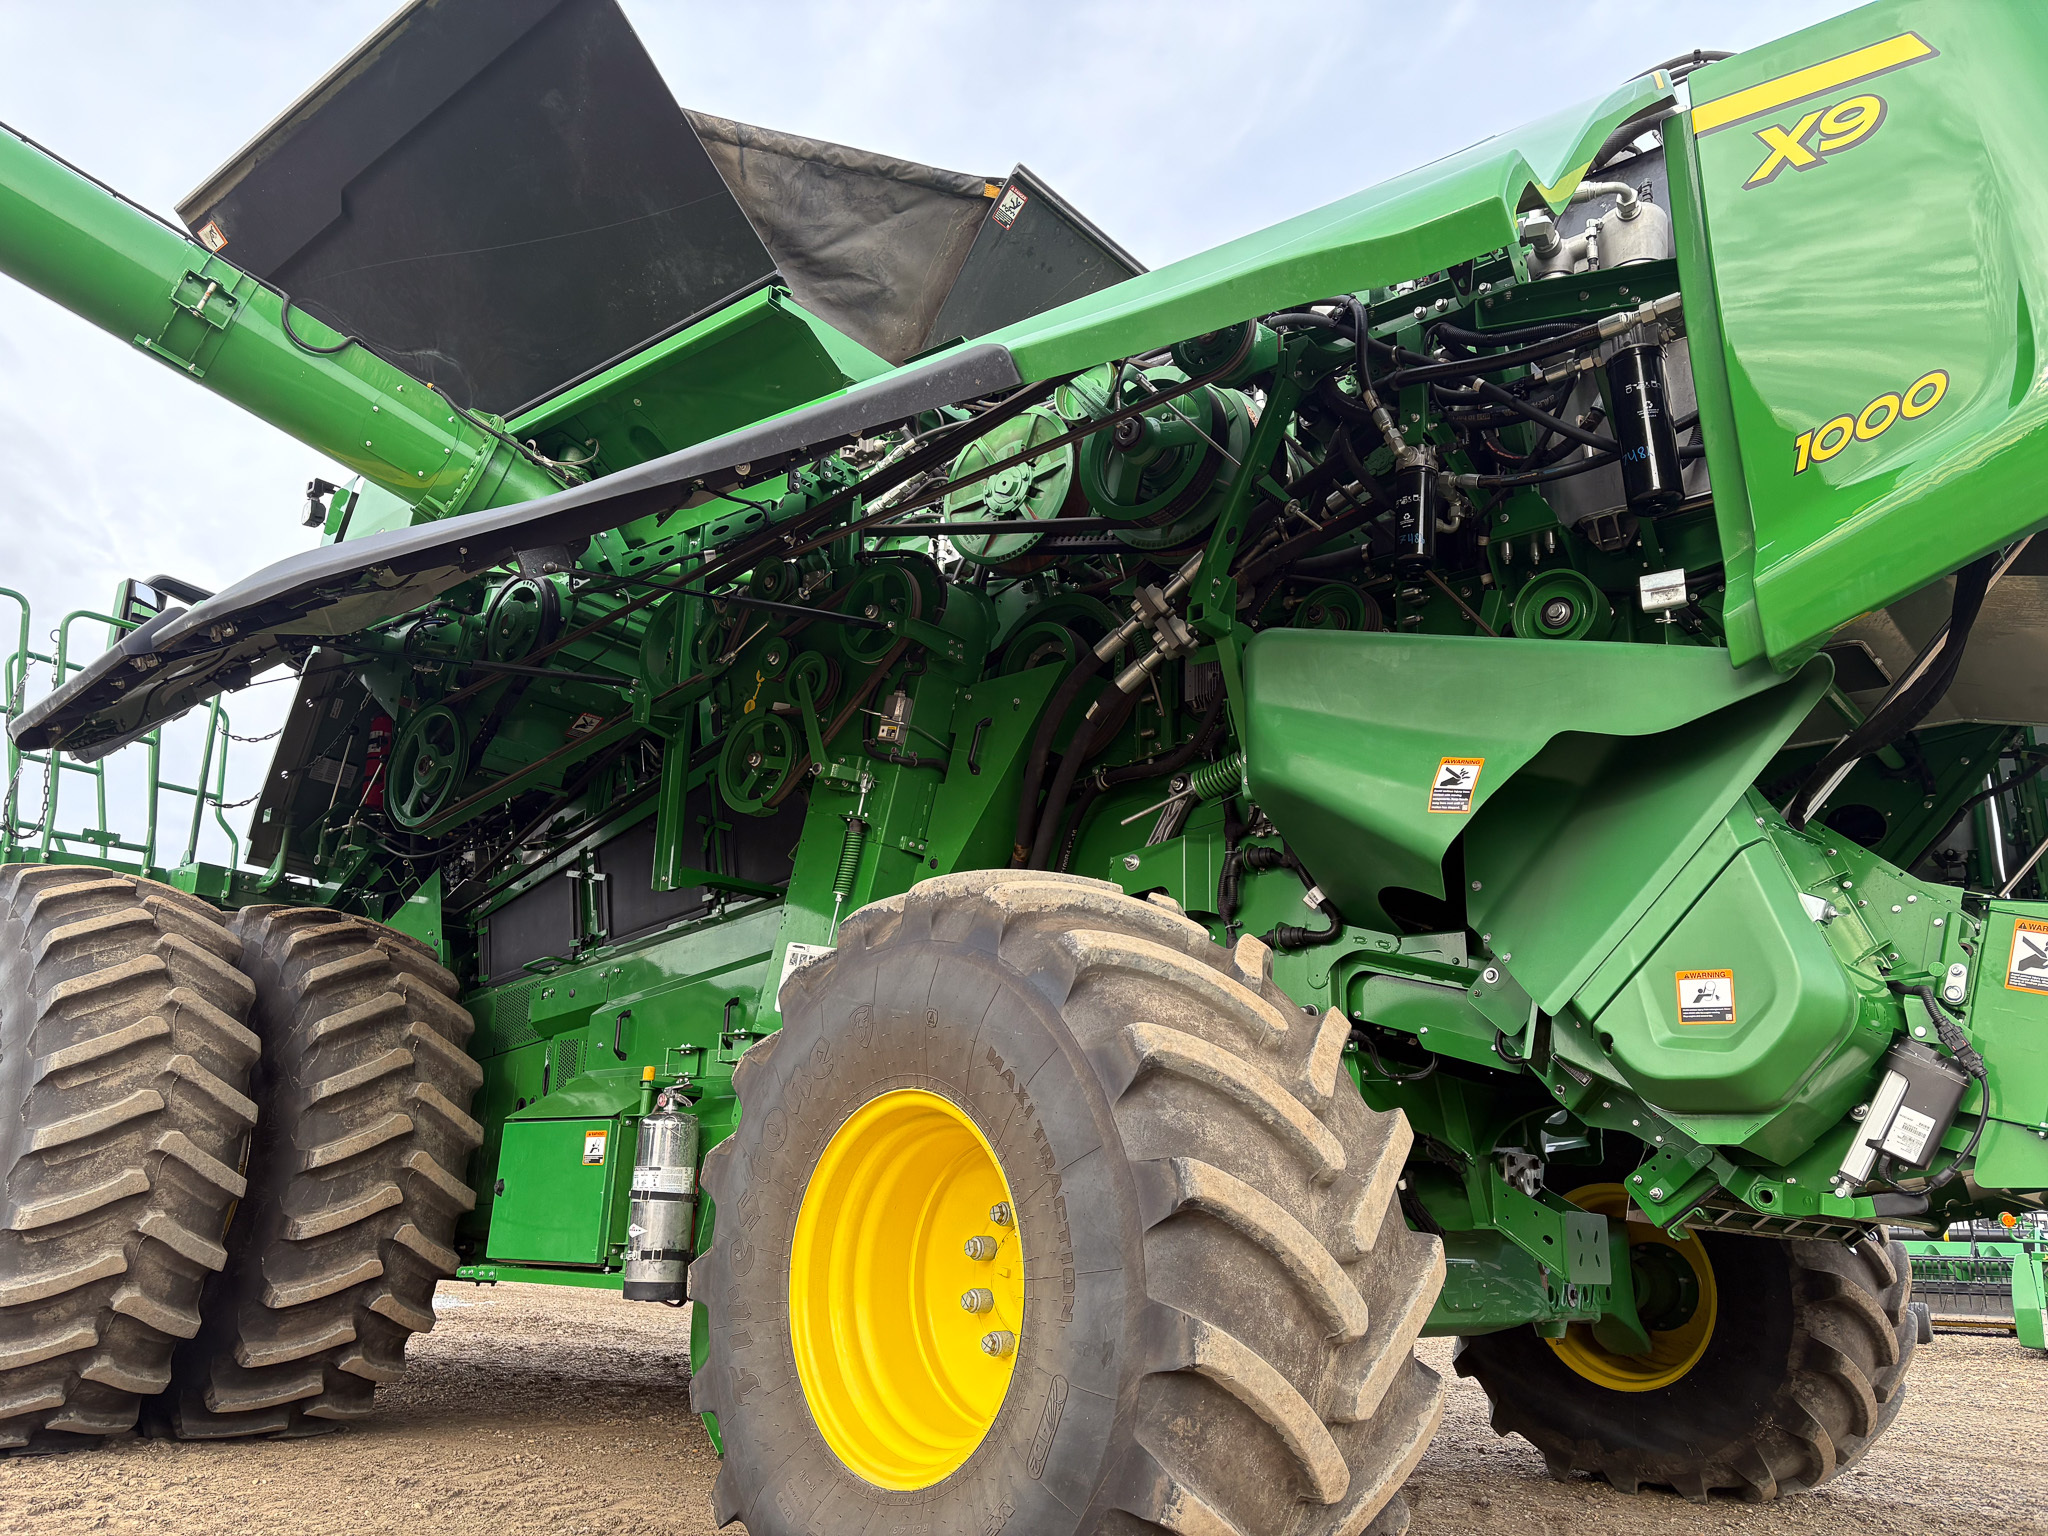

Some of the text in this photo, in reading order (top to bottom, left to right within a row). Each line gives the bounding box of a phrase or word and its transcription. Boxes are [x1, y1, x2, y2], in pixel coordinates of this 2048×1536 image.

[1741, 93, 1888, 191] X9
[1793, 368, 1950, 477] 1000
[1690, 971, 1726, 979] WARNING
[986, 1046, 1076, 1323] MAXI TRACTION
